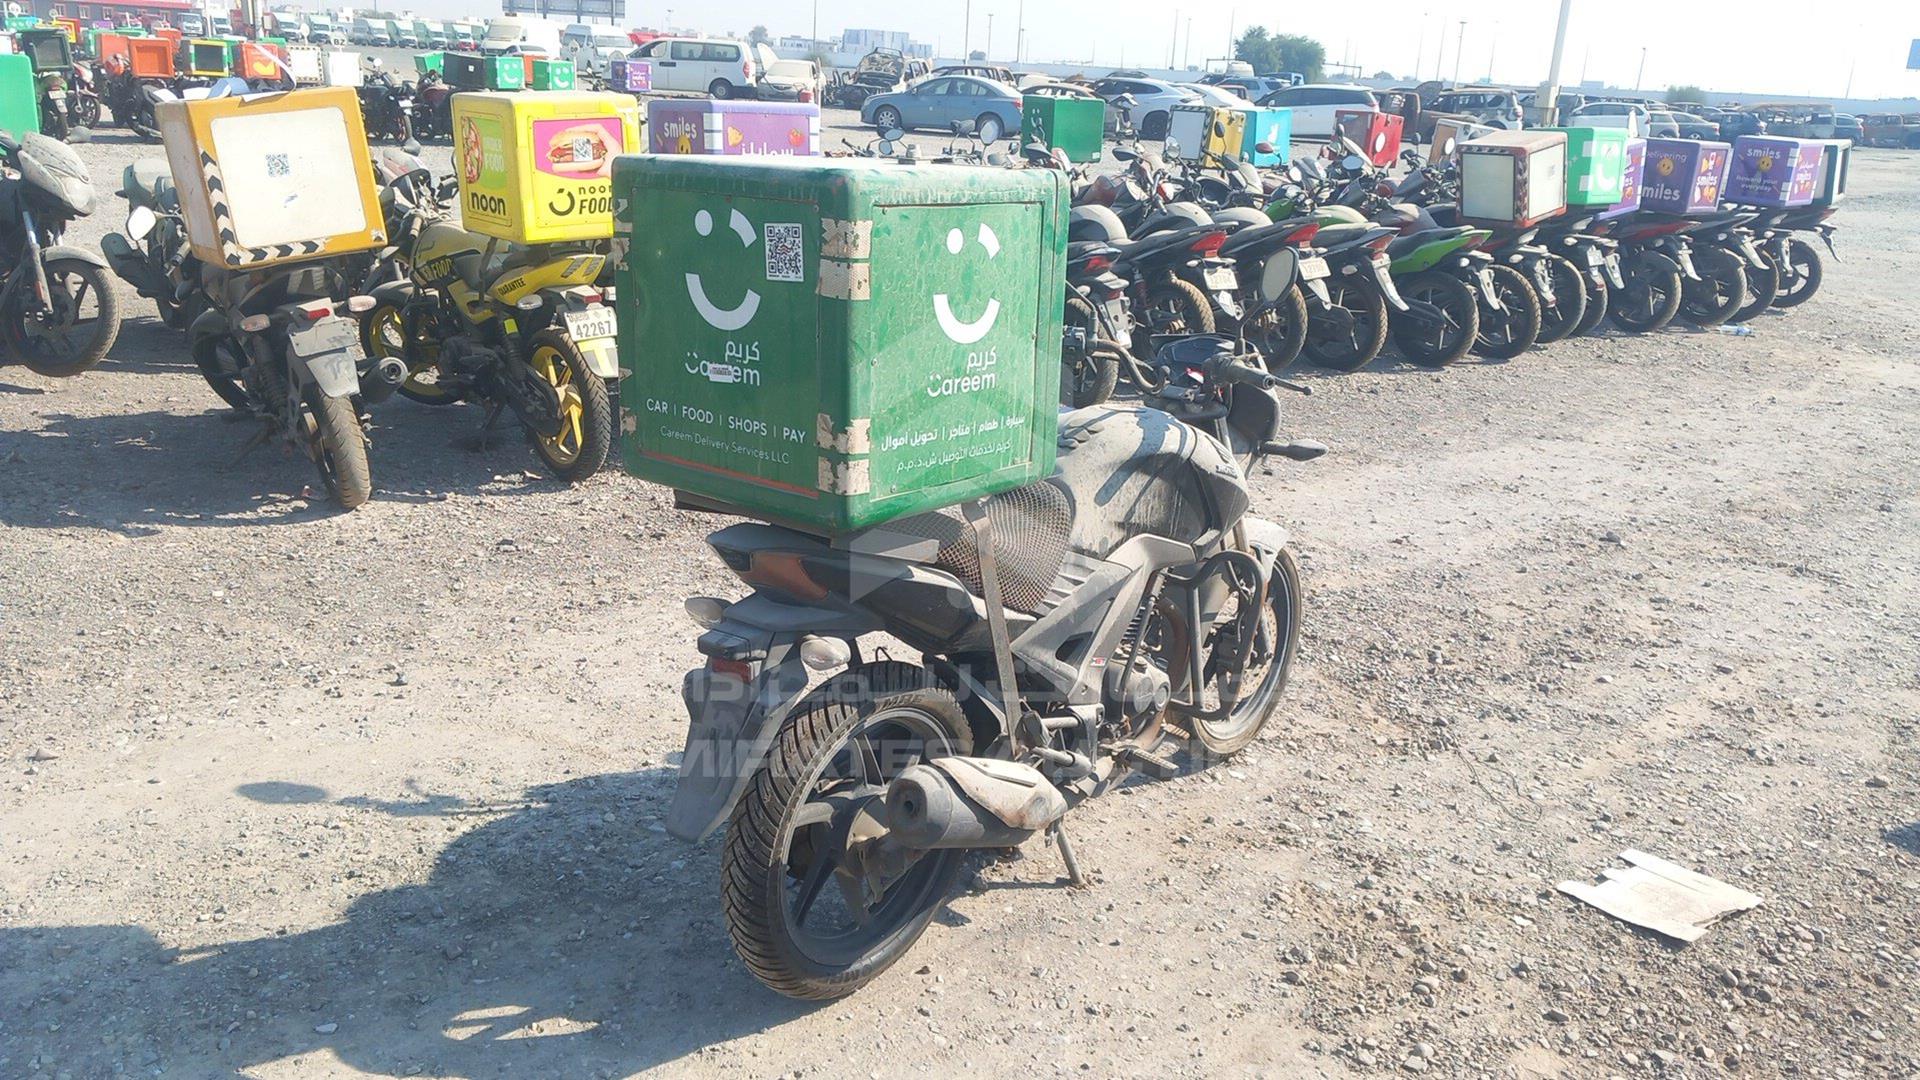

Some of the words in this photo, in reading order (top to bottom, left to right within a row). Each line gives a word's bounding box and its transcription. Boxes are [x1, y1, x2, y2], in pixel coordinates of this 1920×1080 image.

[664, 117, 698, 139] smiles
[1747, 147, 1781, 160] smiles
[1641, 184, 1681, 201] miles
[471, 192, 506, 216] noon
[576, 320, 612, 338] 42267
[724, 340, 761, 364] كريم
[966, 345, 998, 374] كريم
[685, 351, 761, 387] Caem
[646, 398, 669, 415] CAR
[682, 405, 714, 424] FOOD
[728, 415, 768, 436] SHOPS
[783, 427, 806, 444] PAY
[977, 418, 999, 436] طعام
[910, 428, 938, 447] تحويل
[947, 424, 970, 441] متاجر
[660, 425, 693, 442] Careem
[695, 433, 730, 452] Delivery
[731, 441, 769, 461] Services
[771, 450, 790, 465] LLC
